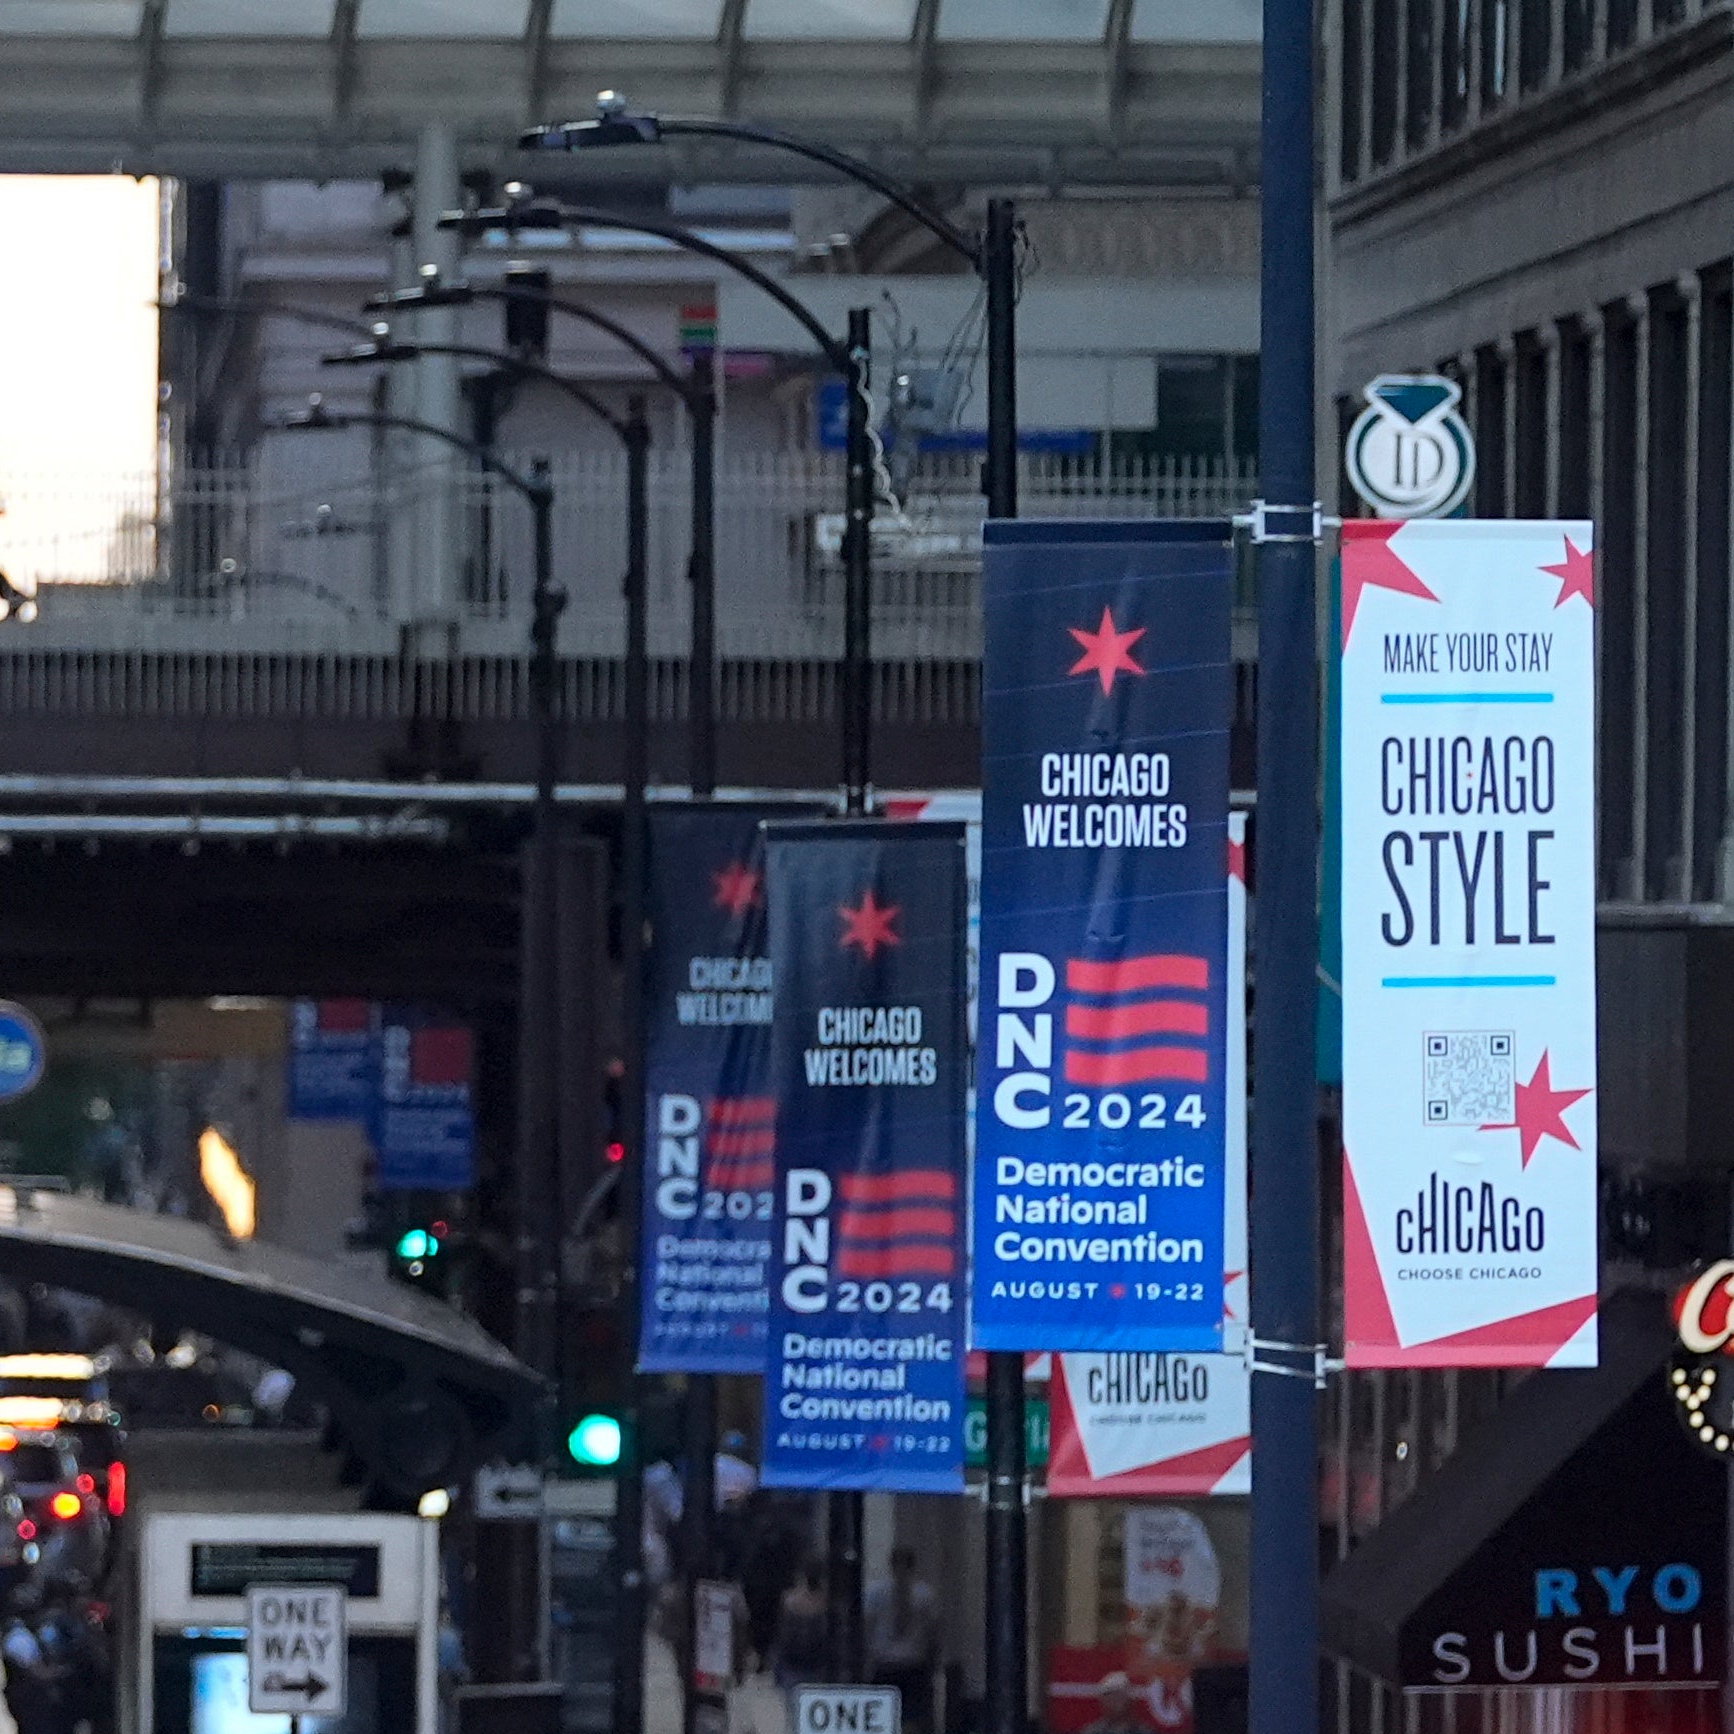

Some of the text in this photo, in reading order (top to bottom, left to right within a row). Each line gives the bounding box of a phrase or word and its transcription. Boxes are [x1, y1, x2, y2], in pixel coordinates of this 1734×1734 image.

[1384, 632, 1553, 674] MAKE YOUR STAY
[1041, 752, 1170, 798] CHICAGO
[1381, 736, 1555, 817] CHICAGO
[1023, 804, 1188, 850] WELCOMES
[1381, 830, 1556, 947] STYLE
[688, 955, 773, 988] CHICAG
[676, 992, 773, 1025] WELCOM
[817, 1006, 923, 1046] CHICAGO
[993, 951, 1056, 1130] DNC
[804, 1047, 938, 1087] WELCOMES
[1062, 1093, 1207, 1130] 2024
[654, 1094, 702, 1222] DNC
[996, 1156, 1205, 1188] Democratic
[702, 1191, 773, 1221] 202
[995, 1193, 1147, 1225] National
[781, 1168, 832, 1314] DNC
[993, 1231, 1204, 1263] Convention
[1398, 1267, 1542, 1281] CHOOSE CHICAGO
[837, 1283, 953, 1313] 2024
[991, 1282, 1205, 1300] AUGUST 19-22
[782, 1333, 953, 1362] Democratic
[782, 1363, 906, 1391] National
[779, 1393, 951, 1423] Convention
[776, 1432, 867, 1450] AUGUST
[1534, 1562, 1703, 1619] RYO
[258, 1597, 329, 1627] ONE
[262, 1631, 334, 1661] WAY
[1433, 1623, 1705, 1683] SUSHI
[808, 1700, 884, 1733] ONE
